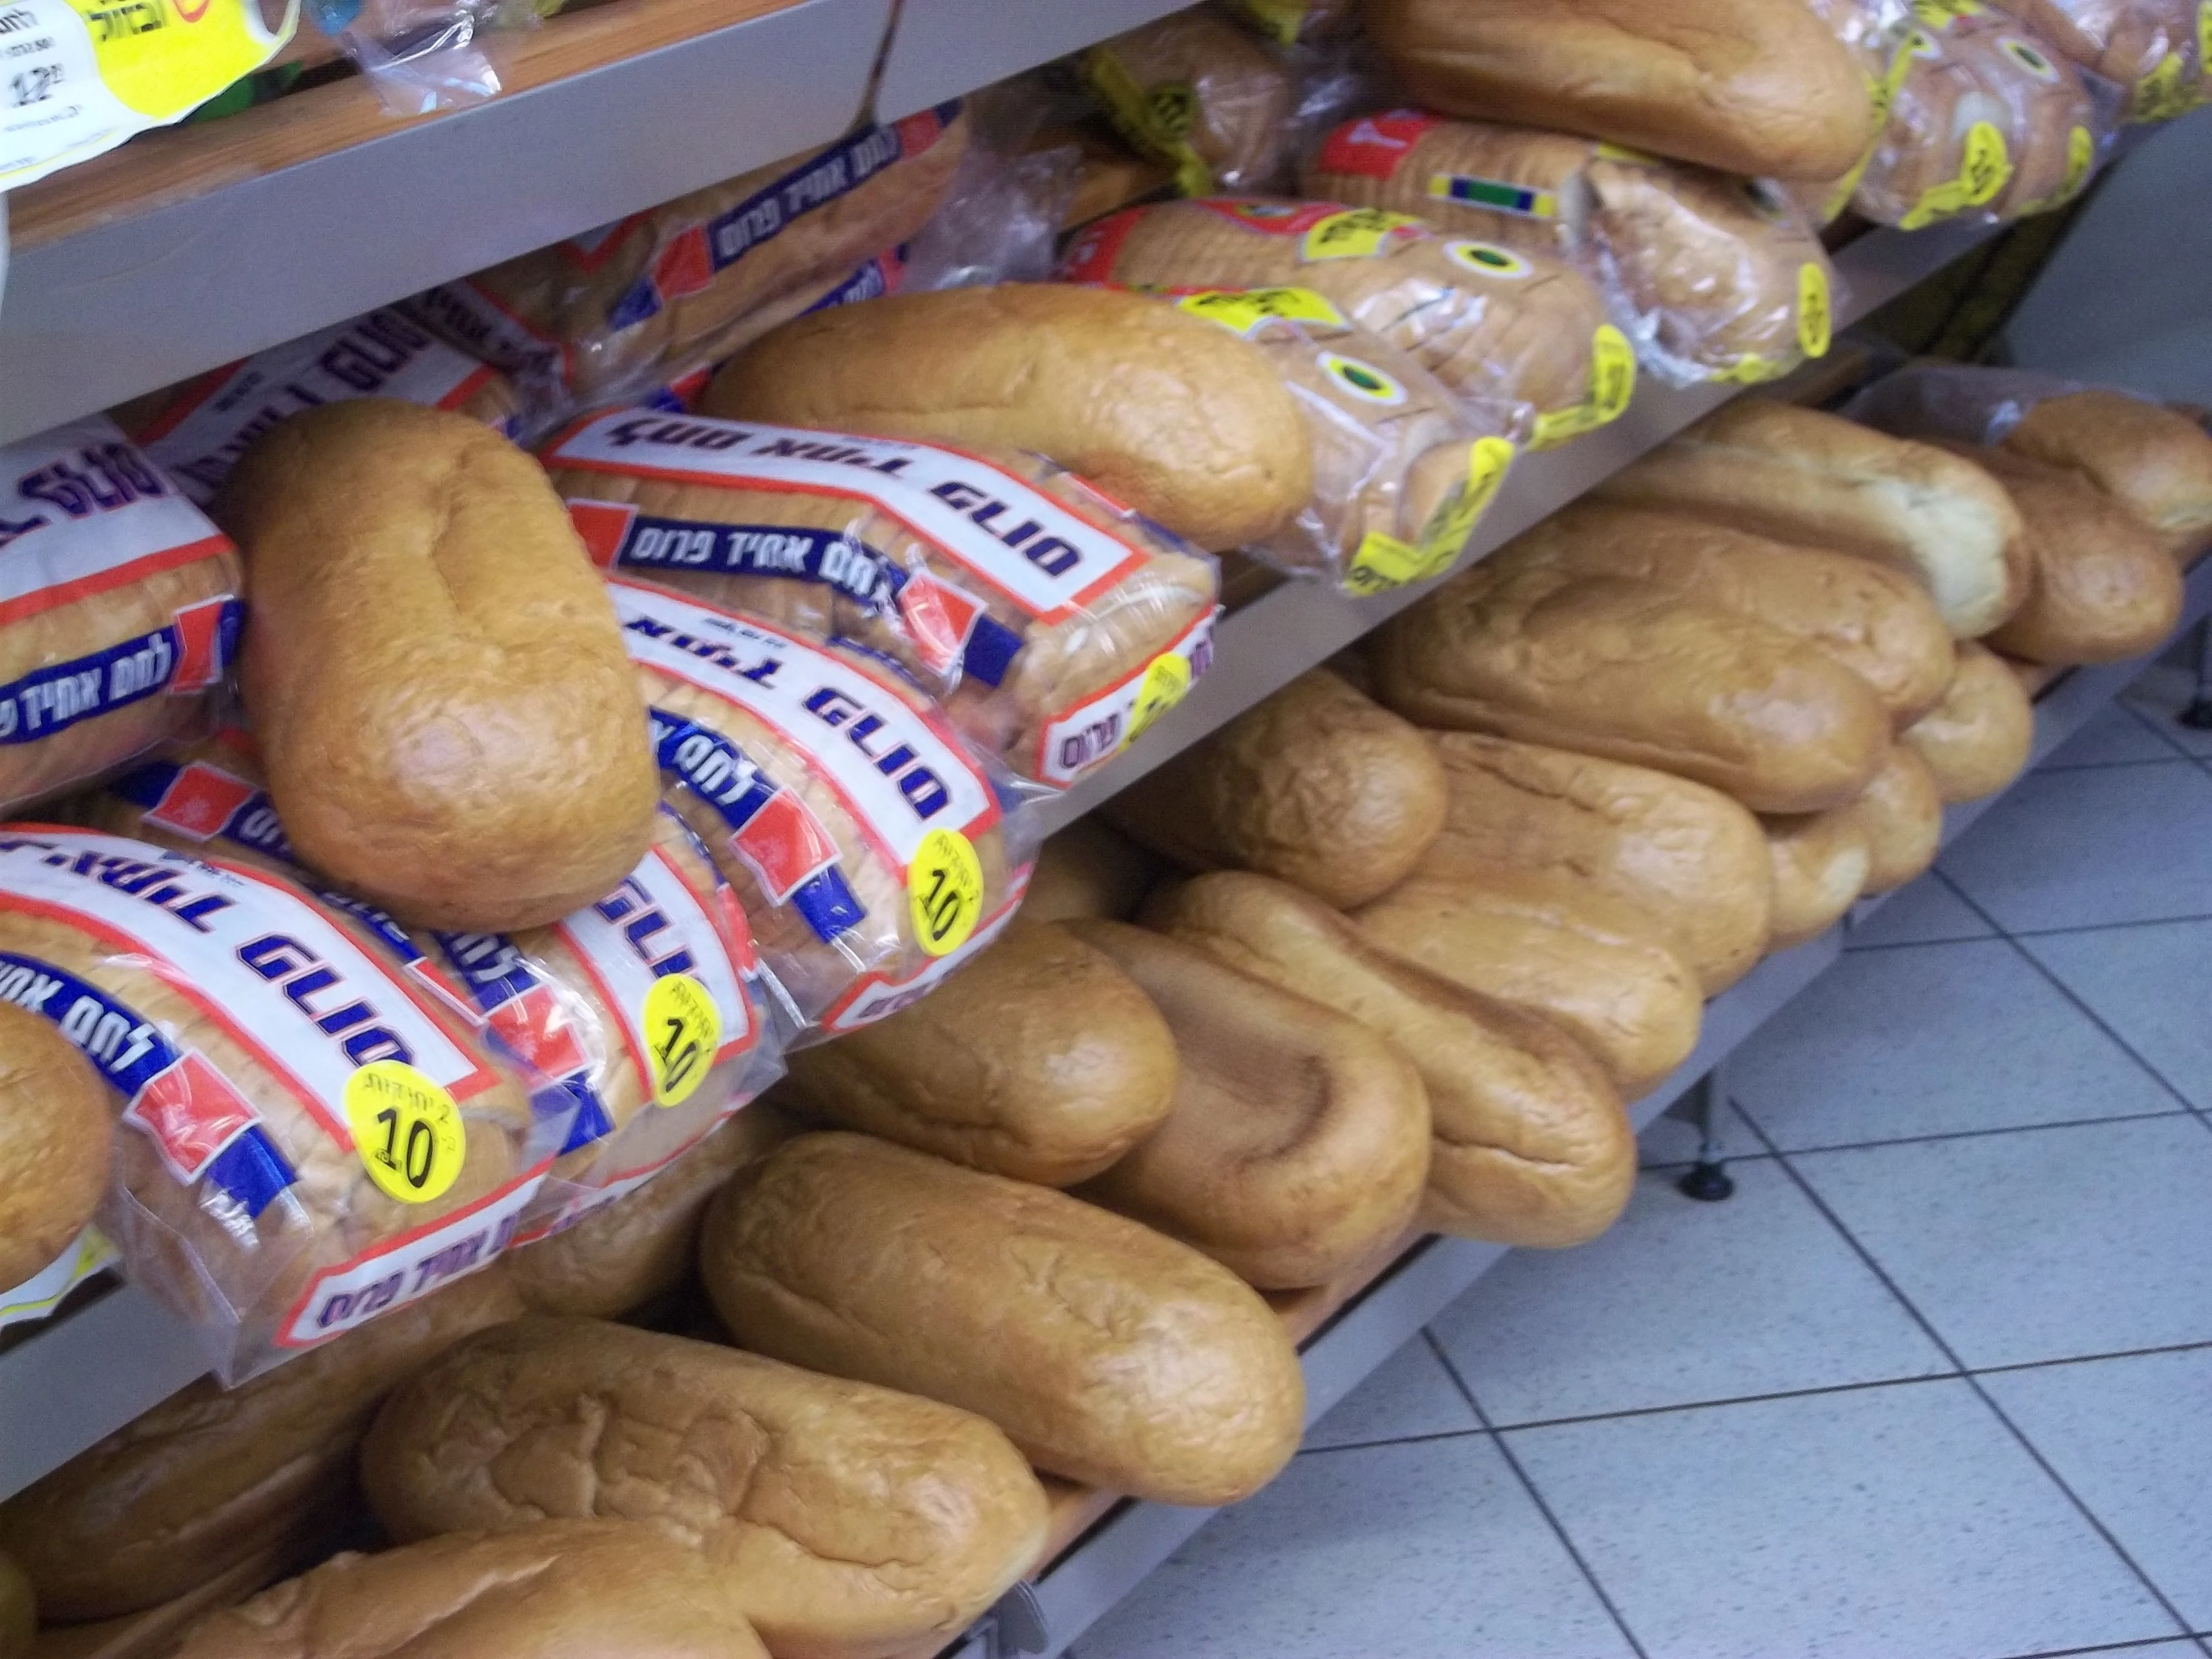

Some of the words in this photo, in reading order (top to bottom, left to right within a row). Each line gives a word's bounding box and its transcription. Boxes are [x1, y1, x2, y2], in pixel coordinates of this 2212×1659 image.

[719, 197, 781, 258] פרוס
[604, 416, 753, 450] לחם
[751, 438, 912, 477] אחיד
[929, 479, 1084, 579] פרוס
[630, 526, 718, 564] פרוס
[726, 531, 813, 573] אחיד
[21, 666, 102, 731] אחיד
[111, 631, 173, 701] לחם
[623, 614, 786, 689] אחיד
[800, 685, 951, 822] פרוס
[673, 733, 758, 806] לחם
[915, 869, 962, 941] 10
[59, 994, 155, 1073] לחם
[235, 931, 416, 1069] פרוס
[653, 1018, 697, 1093] 10
[375, 1107, 435, 1190] 10
